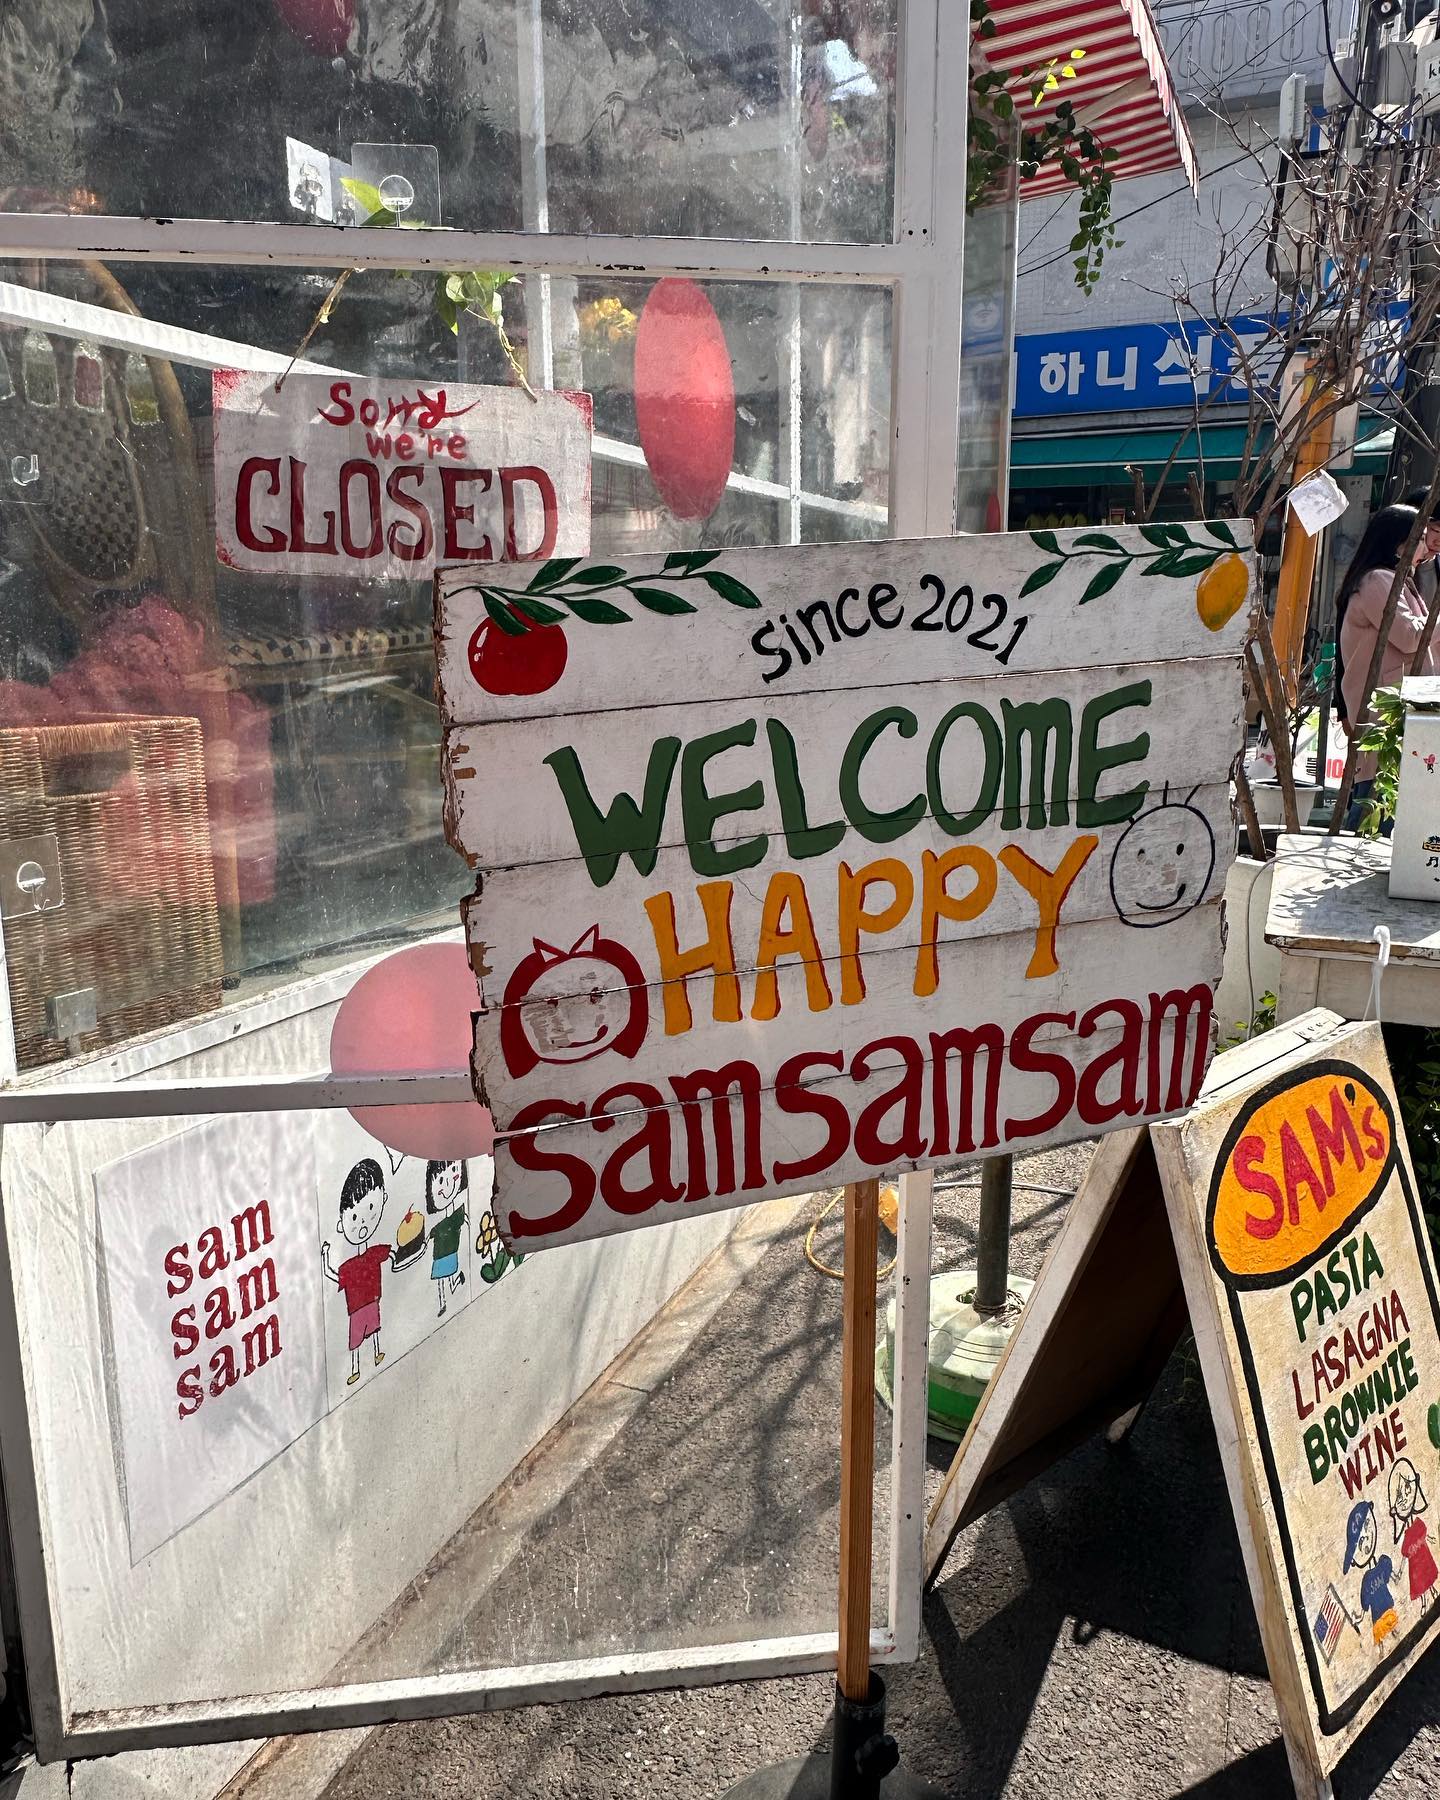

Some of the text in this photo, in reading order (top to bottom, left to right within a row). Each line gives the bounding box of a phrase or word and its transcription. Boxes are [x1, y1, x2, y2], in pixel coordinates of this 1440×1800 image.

[317, 382, 481, 430] Sorry
[366, 429, 468, 461] we're
[235, 455, 558, 561] CLOSED
[911, 573, 1030, 666] 2021
[542, 679, 1153, 888] WELCOME
[643, 834, 1099, 1037] HAPPY
[164, 1199, 275, 1299] sam
[1289, 1231, 1384, 1343] PASTA
[171, 1256, 281, 1361] sam
[1292, 1289, 1410, 1421] LASAGNA
[176, 1313, 284, 1421] sam
[1303, 1337, 1419, 1486] BROWNIE
[1338, 1407, 1408, 1500] WINE
